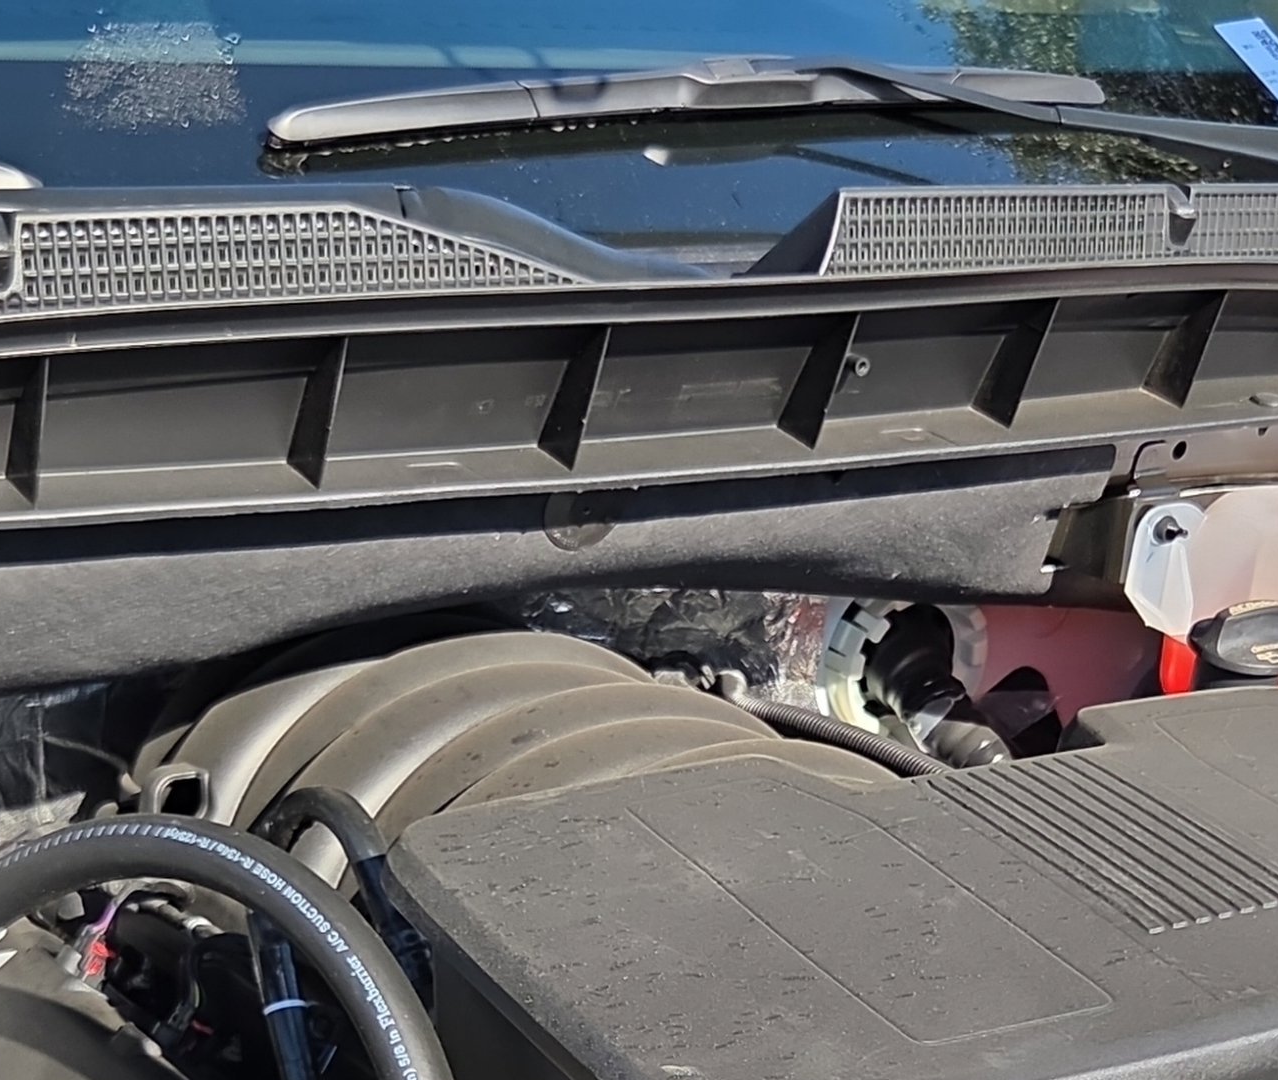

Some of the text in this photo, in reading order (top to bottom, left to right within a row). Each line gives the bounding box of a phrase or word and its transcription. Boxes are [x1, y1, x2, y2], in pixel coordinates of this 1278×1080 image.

[251, 861, 287, 891] HOSE
[281, 884, 331, 933] SUCTION
[327, 933, 349, 953] A/C
[346, 954, 396, 1030] Flexbarrier
[393, 1045, 411, 1068] 5/8
